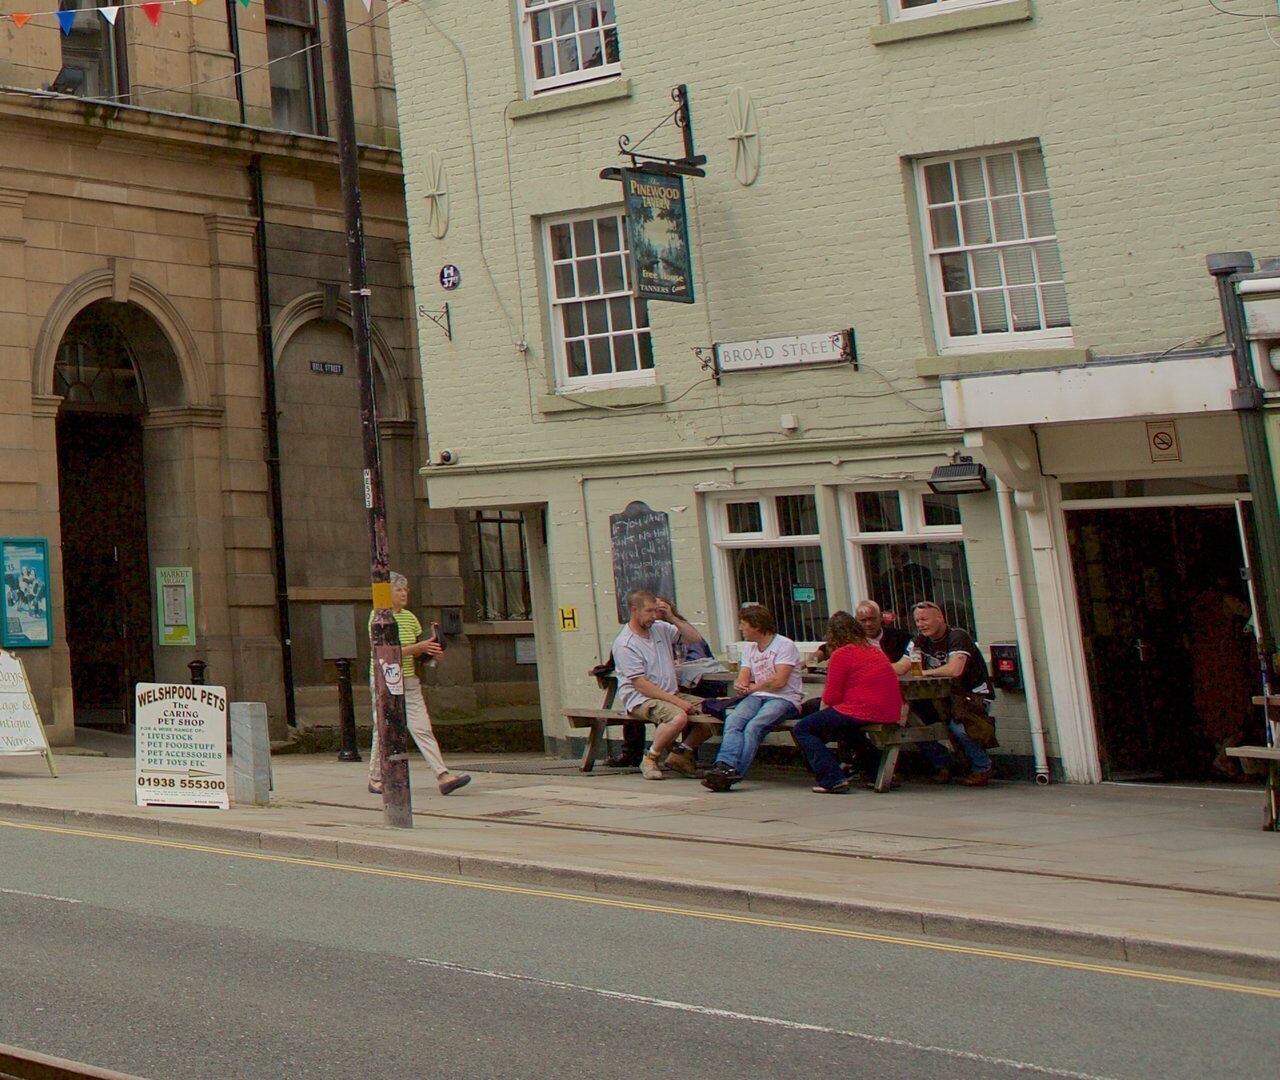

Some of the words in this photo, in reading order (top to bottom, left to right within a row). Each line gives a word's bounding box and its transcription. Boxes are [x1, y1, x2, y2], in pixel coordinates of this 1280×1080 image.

[630, 180, 680, 199] PINEWOOD
[444, 266, 454, 277] H
[723, 345, 775, 363] BROAD
[781, 340, 837, 357] STREET
[561, 608, 576, 629] H
[137, 685, 198, 709] WELSHPOOL
[200, 688, 225, 712] PETS
[173, 701, 189, 709] The
[163, 709, 199, 718] CARING
[158, 717, 175, 726] PET
[178, 719, 205, 727] SHOP
[1, 735, 36, 746] Wares
[147, 733, 193, 741] LIVESTOCK
[165, 742, 215, 751] FOODSTUFF
[165, 750, 222, 759] ACCESSORIES
[166, 759, 188, 767] TOYS
[138, 777, 175, 788] 01938
[180, 779, 225, 790] 555300
